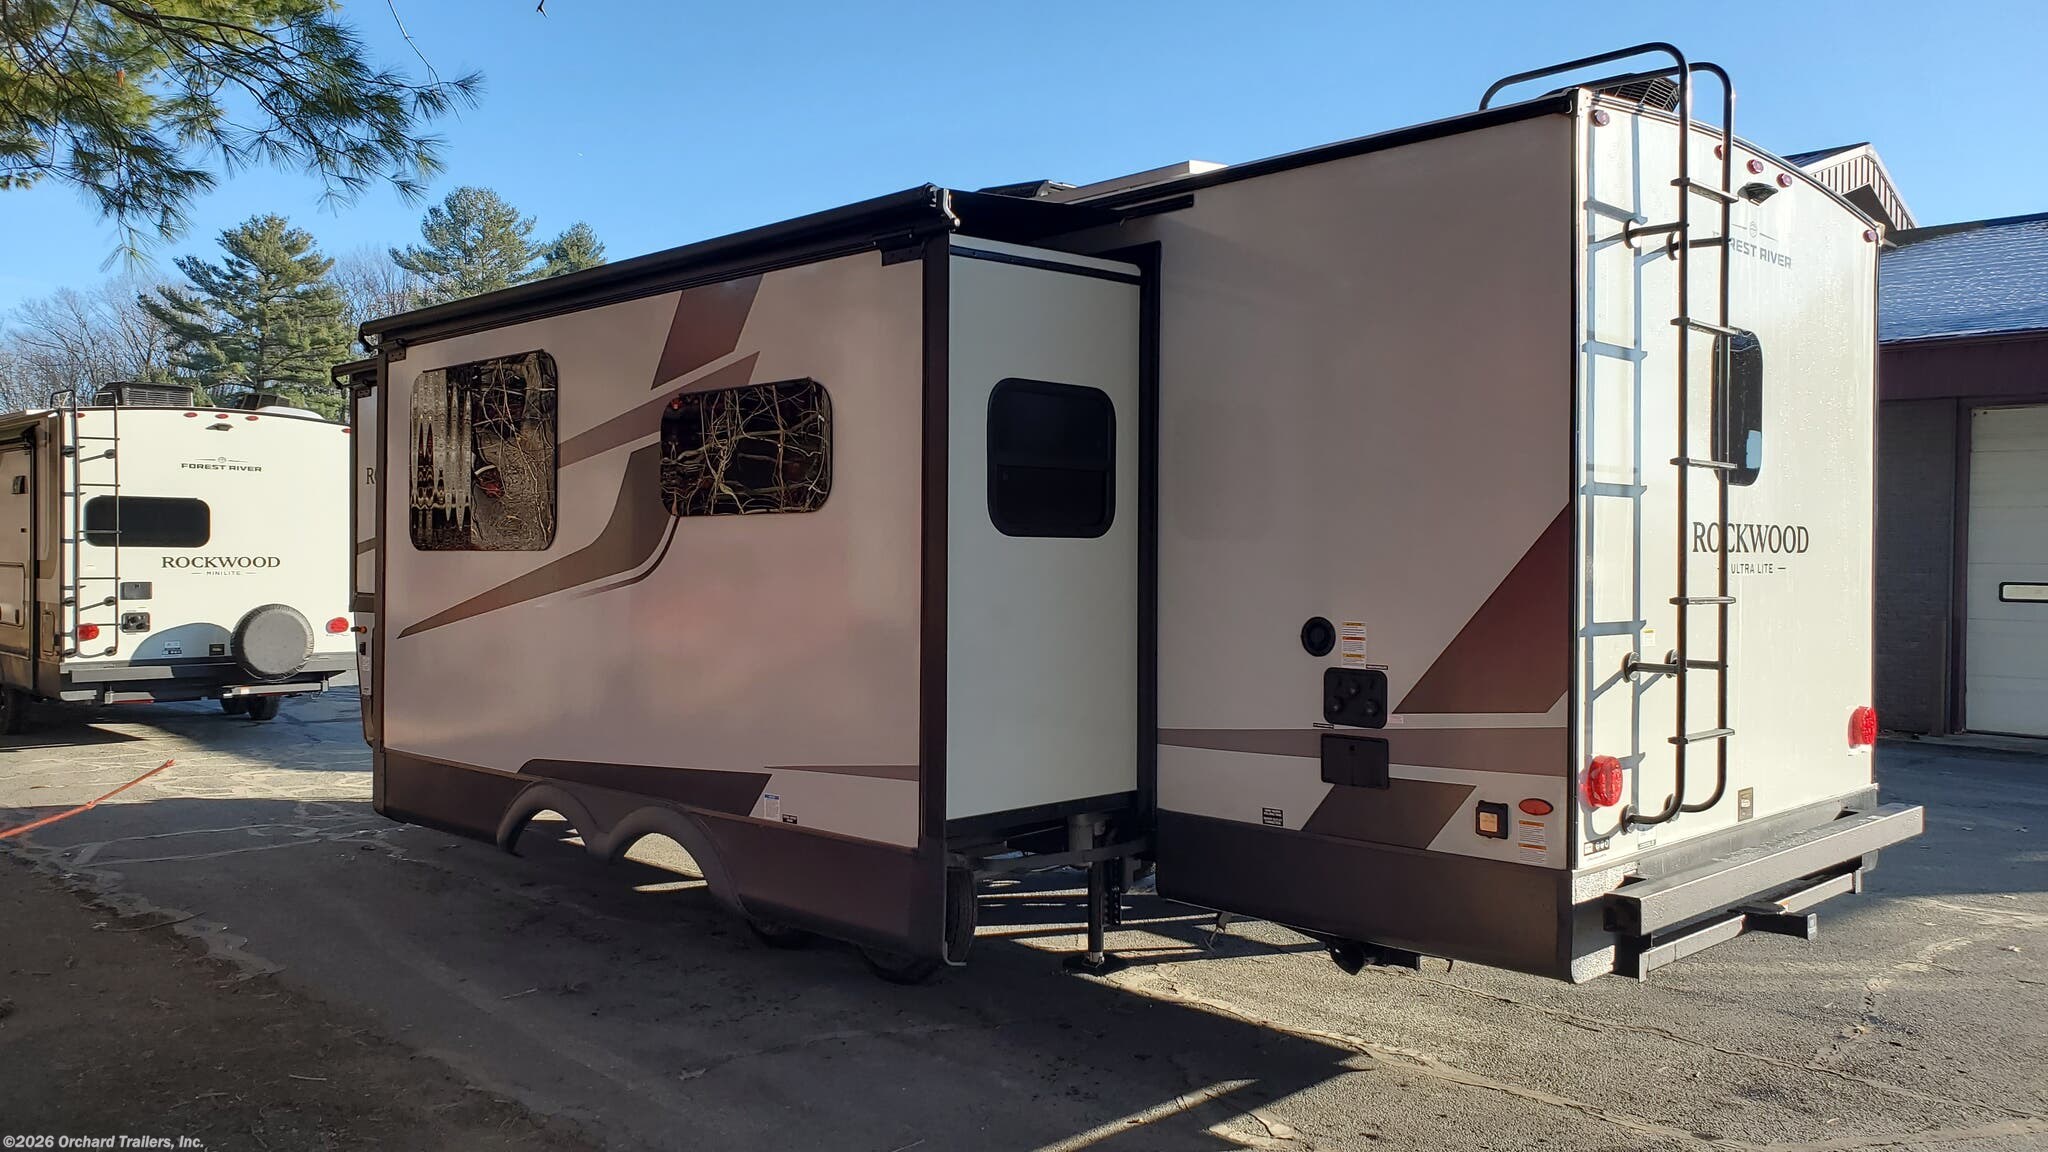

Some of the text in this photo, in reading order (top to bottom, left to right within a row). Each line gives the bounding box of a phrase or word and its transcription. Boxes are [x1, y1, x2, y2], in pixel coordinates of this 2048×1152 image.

[1760, 247, 1792, 269] RIVER
[181, 463, 226, 471] FOREST
[161, 556, 281, 569] ROCKWOOD
[1731, 563, 1774, 574] ULTRA LITE
